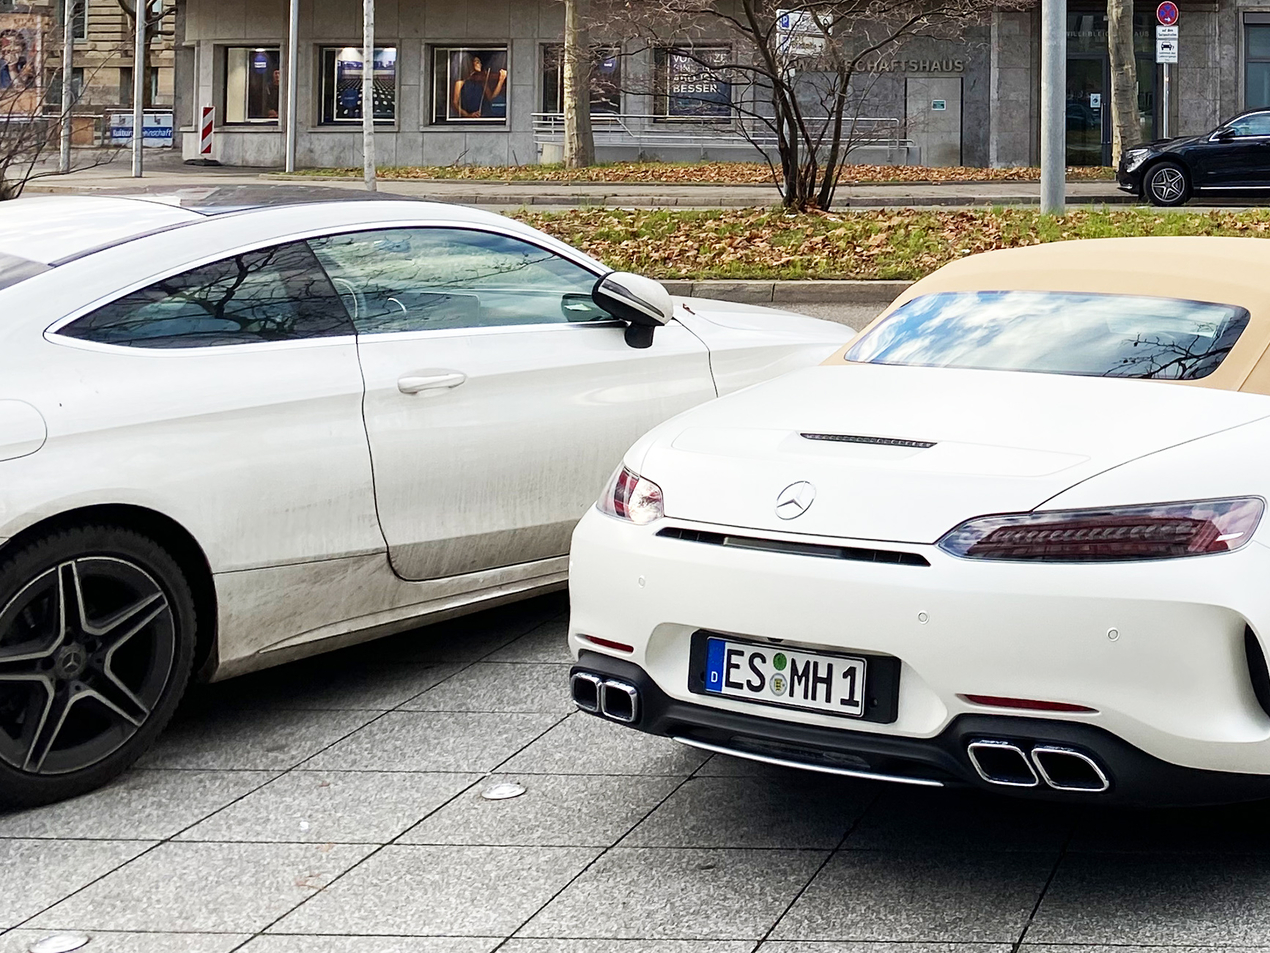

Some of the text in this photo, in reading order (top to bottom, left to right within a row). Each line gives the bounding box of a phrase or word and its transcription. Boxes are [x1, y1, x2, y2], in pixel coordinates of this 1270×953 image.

[710, 671, 718, 683] D
[725, 648, 860, 708] ES MH 1
